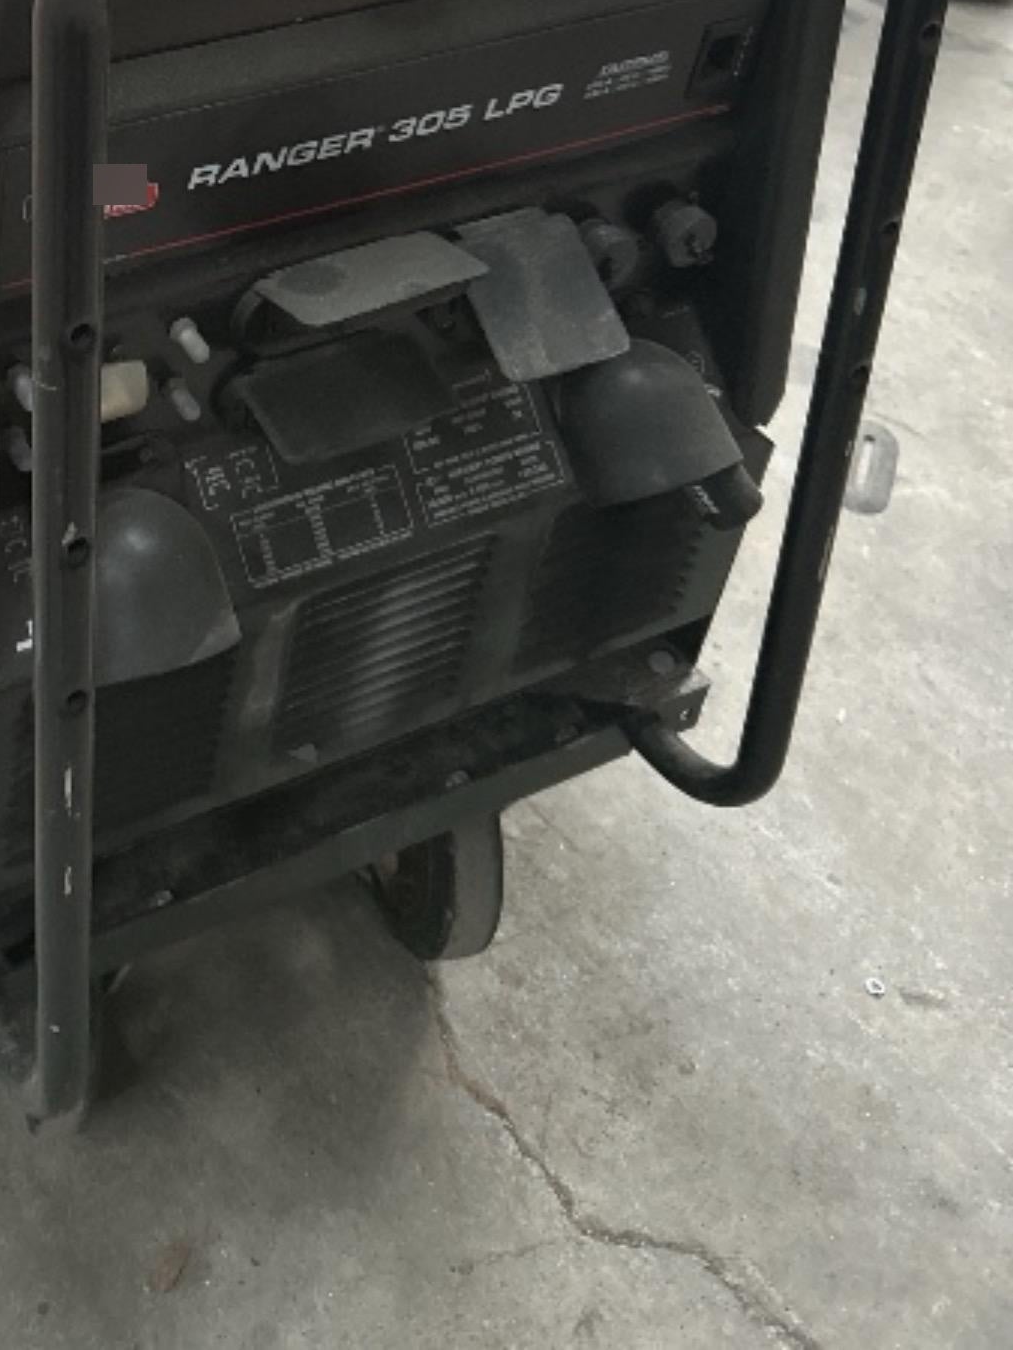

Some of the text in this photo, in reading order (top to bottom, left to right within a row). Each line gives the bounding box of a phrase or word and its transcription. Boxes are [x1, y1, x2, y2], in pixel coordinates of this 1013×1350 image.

[187, 82, 565, 191] RANGER 305 LPG
